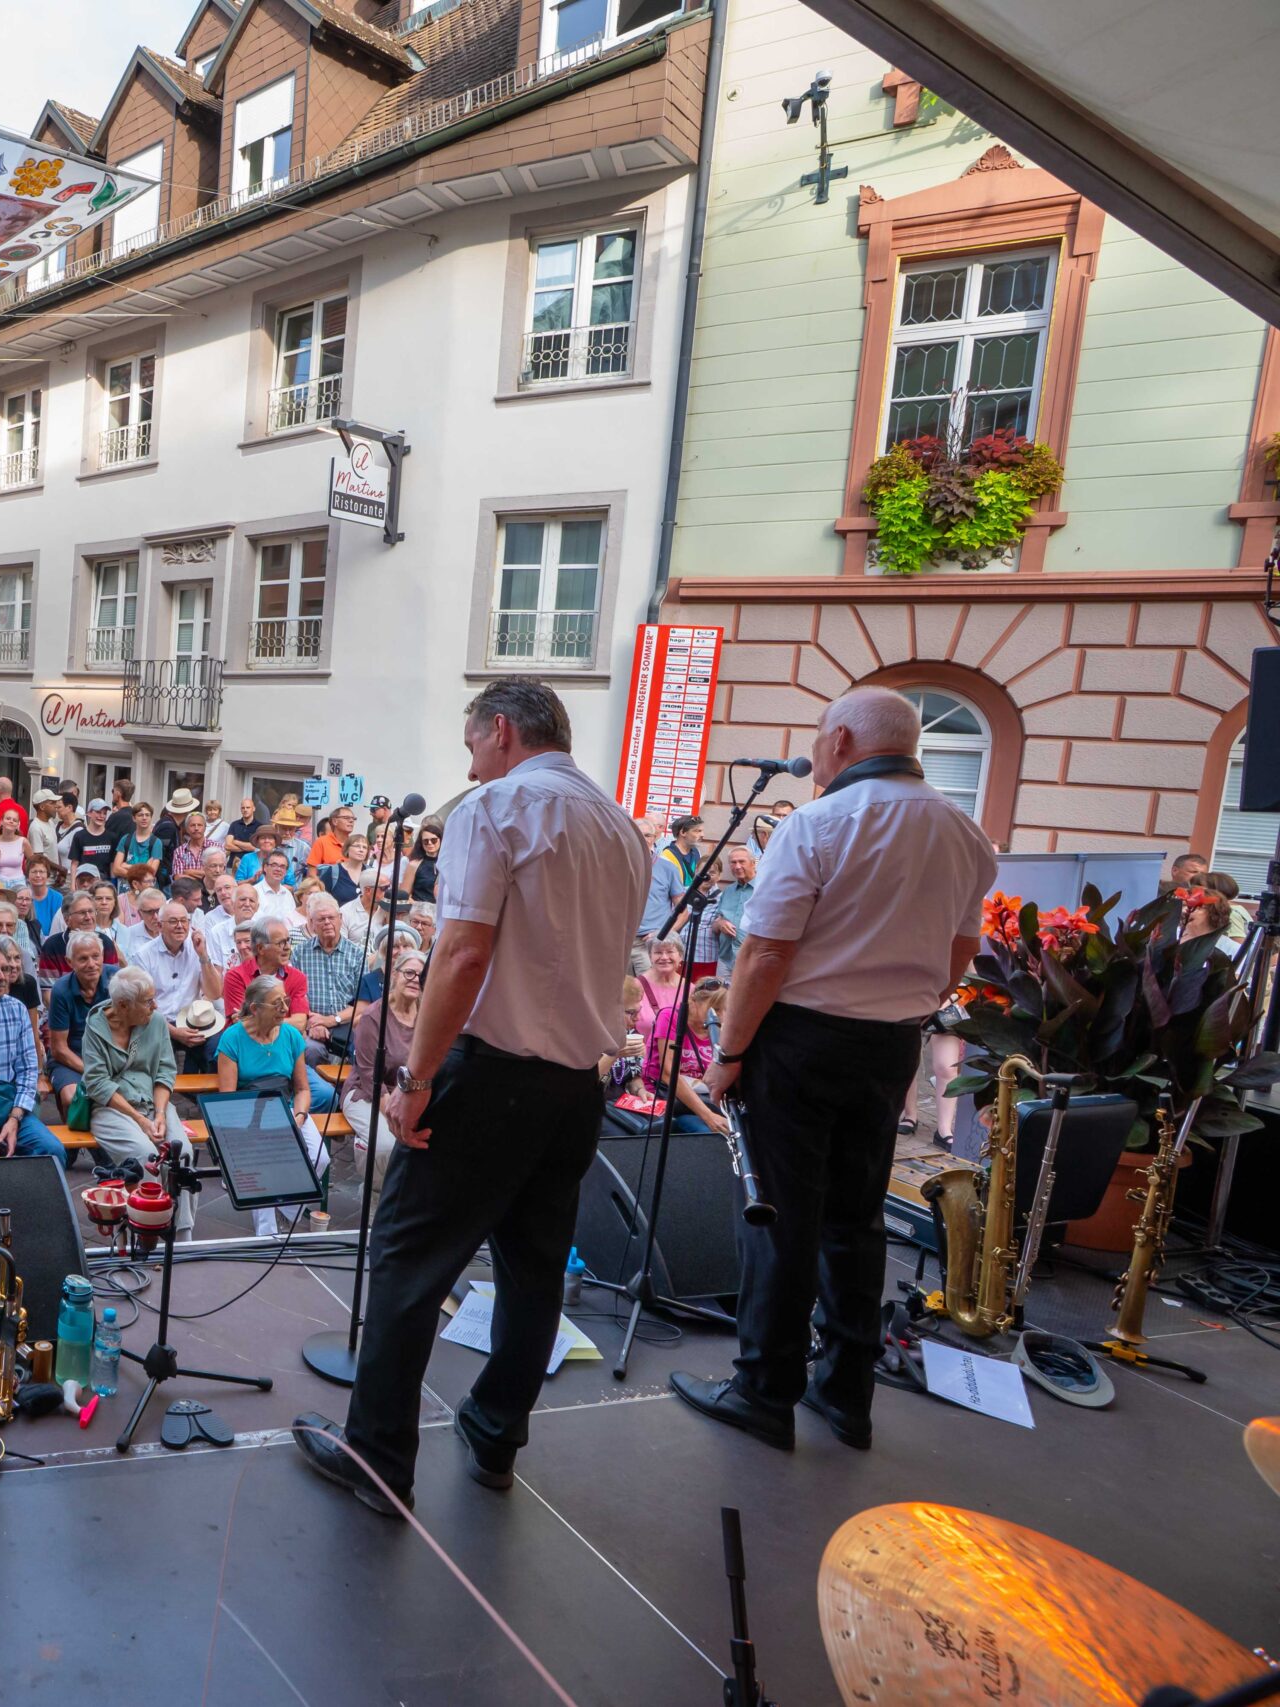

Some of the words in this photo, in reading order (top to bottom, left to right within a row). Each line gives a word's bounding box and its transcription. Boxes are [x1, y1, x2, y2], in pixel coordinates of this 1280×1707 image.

[335, 470, 385, 498] Martino
[334, 494, 383, 518] Ristorante
[63, 702, 127, 732] Martino
[631, 726, 641, 758] Jazzfest
[329, 763, 341, 775] 36
